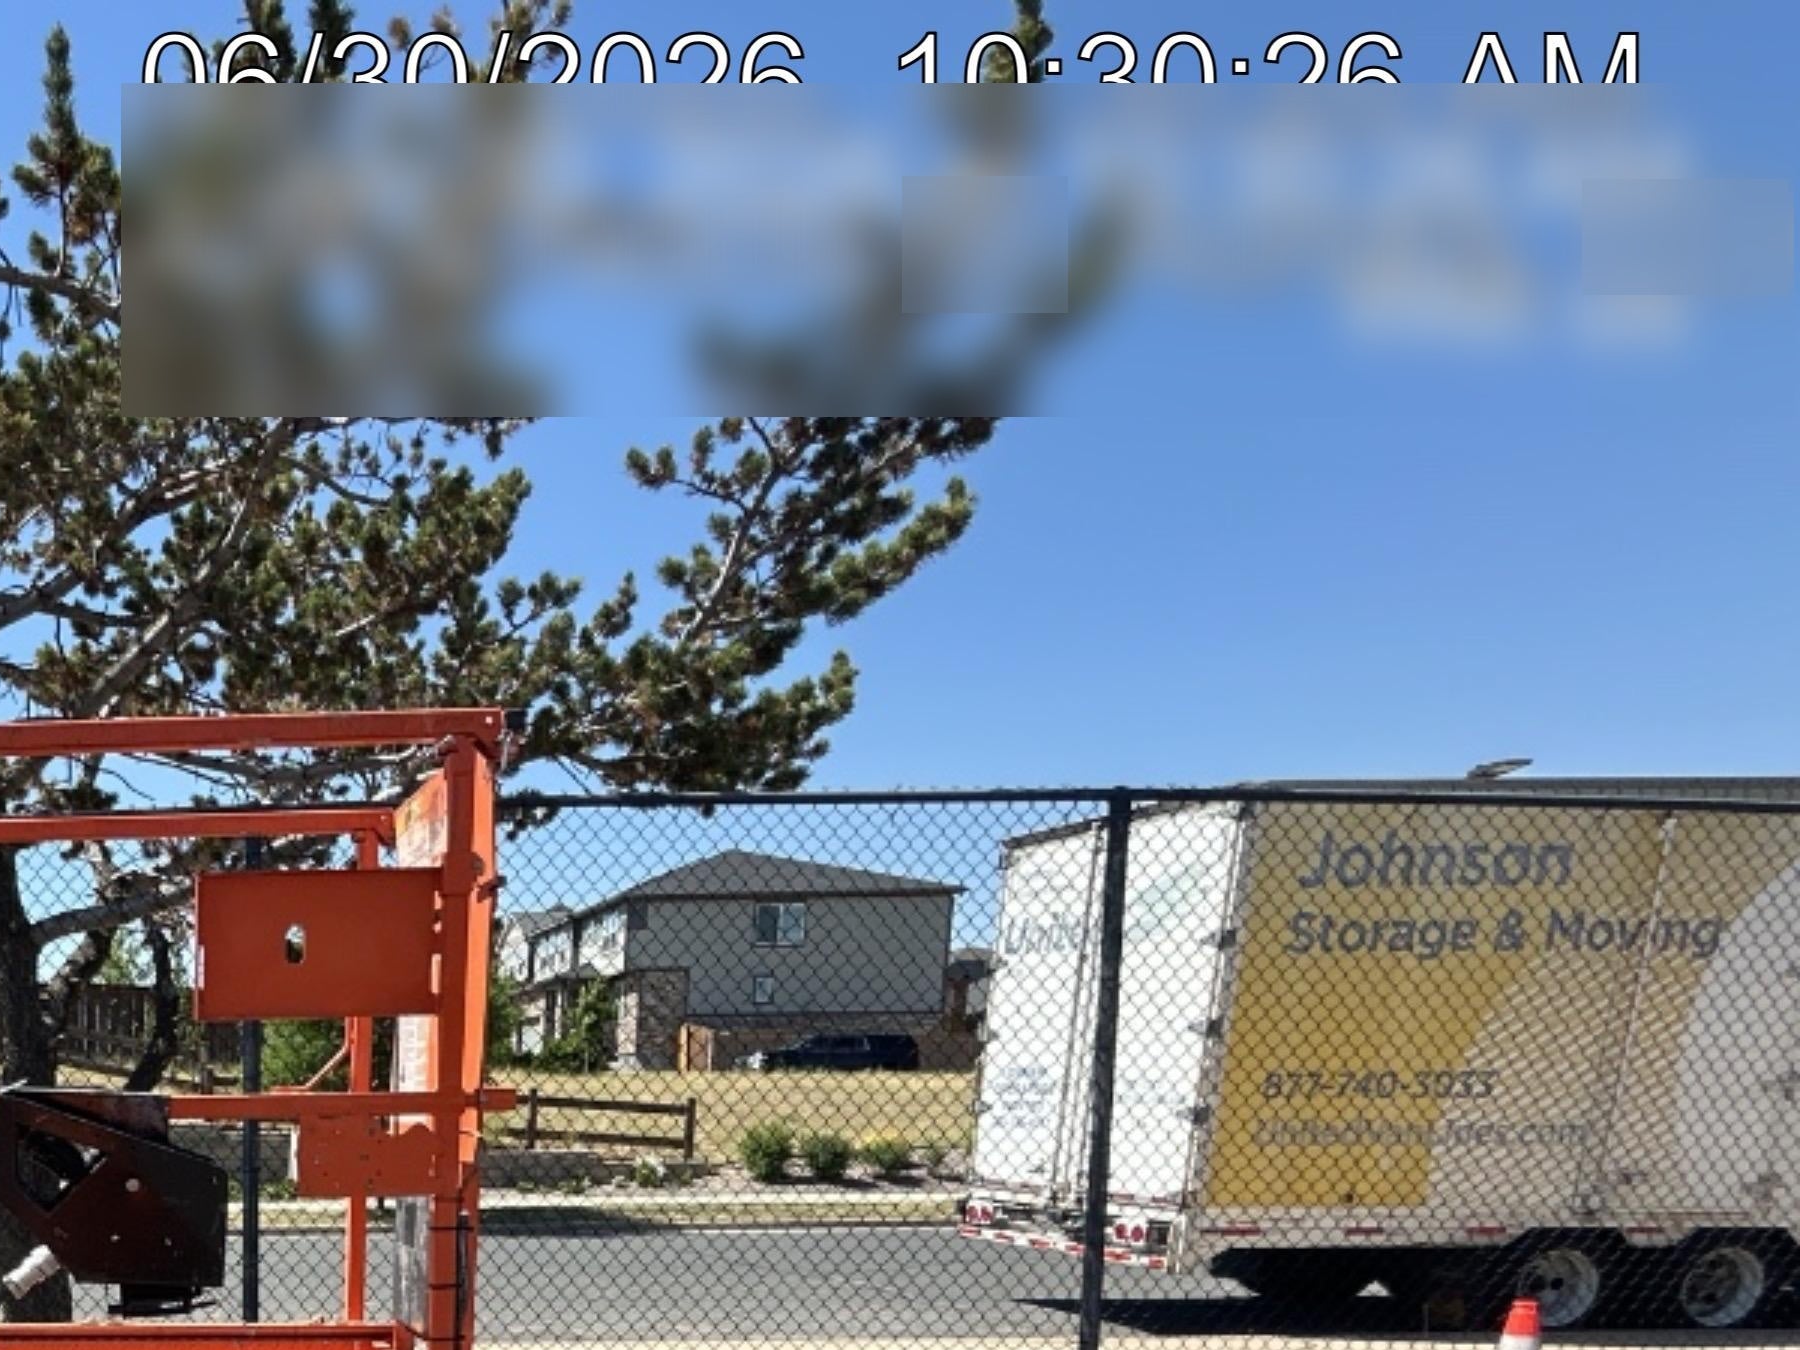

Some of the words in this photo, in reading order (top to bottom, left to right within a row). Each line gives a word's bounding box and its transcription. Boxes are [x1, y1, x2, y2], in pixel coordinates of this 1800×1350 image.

[1299, 829, 1574, 889] Johnson
[1284, 911, 1480, 961] Storage
[1494, 908, 1528, 952] &
[1546, 908, 1722, 960] Moving
